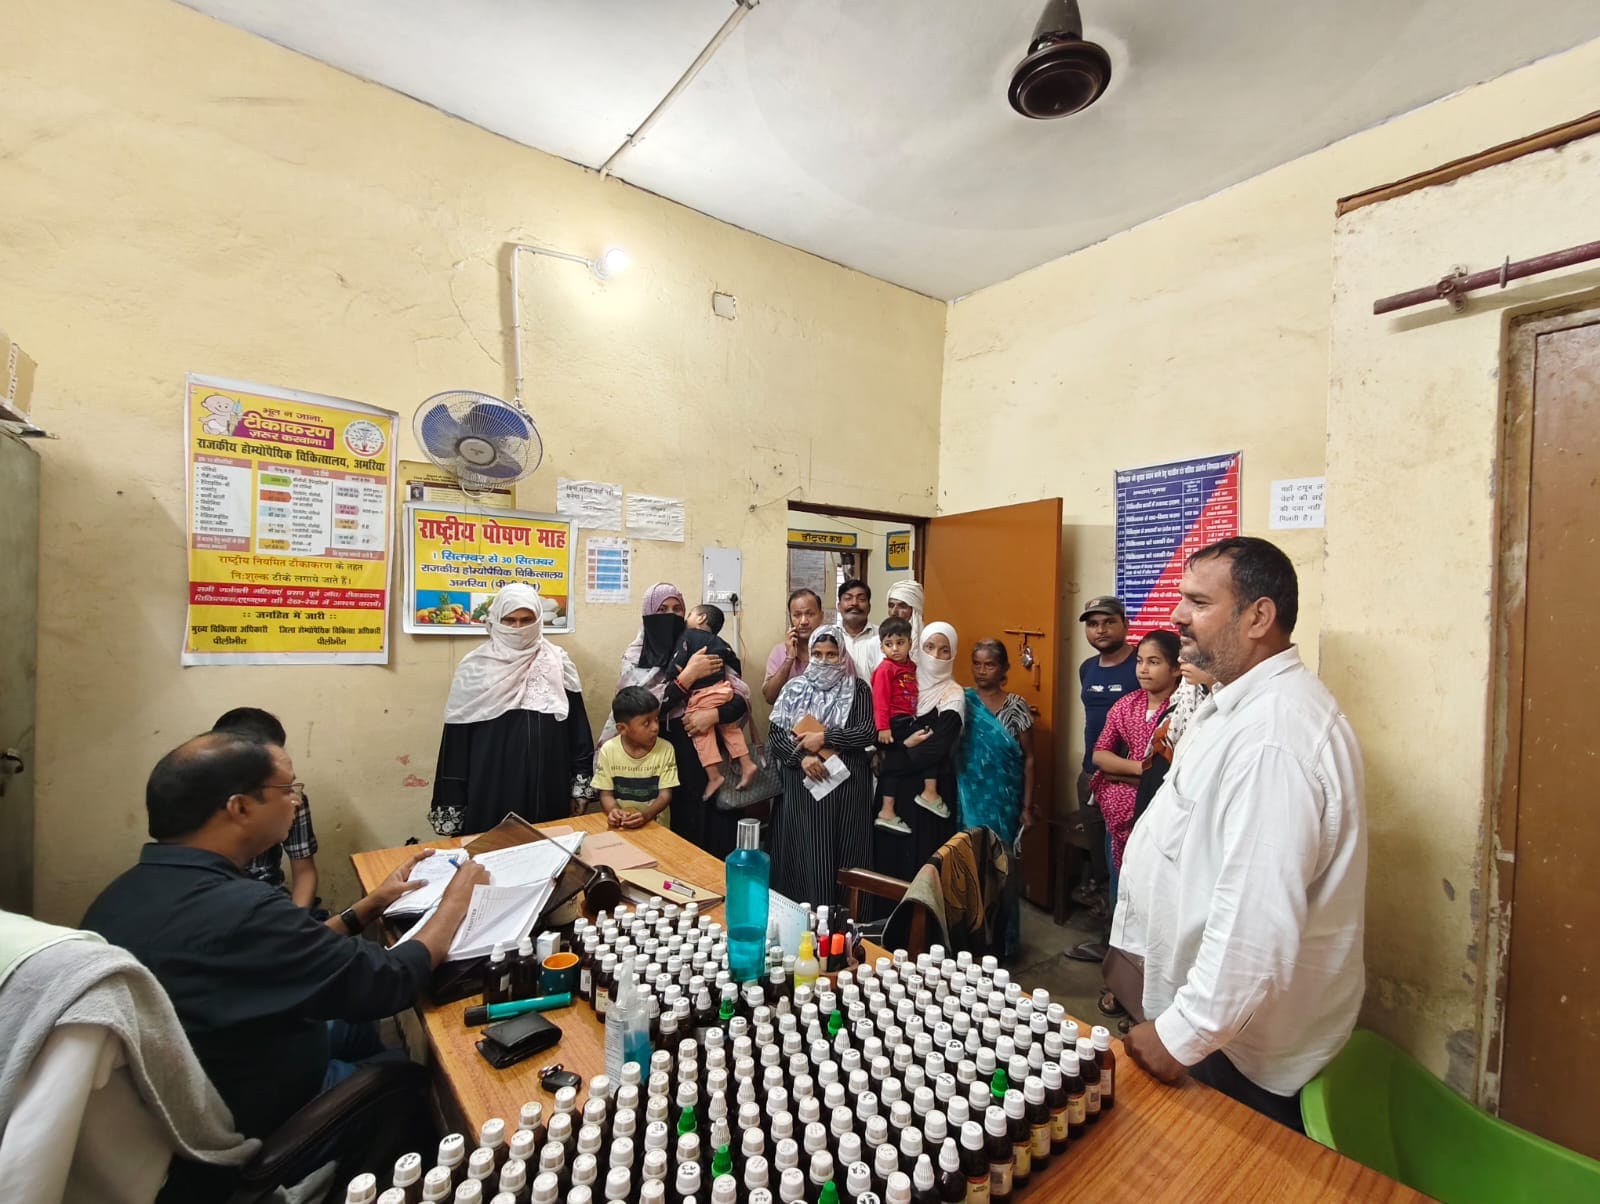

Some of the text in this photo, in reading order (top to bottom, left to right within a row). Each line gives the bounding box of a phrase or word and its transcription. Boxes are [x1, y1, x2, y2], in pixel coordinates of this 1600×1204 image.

[263, 408, 280, 417] भूल
[243, 412, 332, 439] टीकाकरण
[197, 438, 386, 472] राजकीय होम्योपैथिक चिकित्सालय, अमरिया
[418, 516, 566, 548] राष्ट्रीय पोषण माह
[889, 541, 906, 554] डॉट्स
[218, 555, 363, 572] राष्ट्रीय नियमित टीकाकरण के तहत
[442, 550, 484, 562] सितम्बर
[488, 554, 498, 563] से
[502, 556, 512, 564] 30
[516, 554, 554, 566] सितम्बर
[272, 572, 291, 582] टीके
[322, 575, 338, 584] जाते
[421, 564, 563, 579] राजकीय होम्योपैथिक चिकित्सालय
[449, 578, 487, 588] अमरिया
[256, 610, 289, 619] जनहित
[293, 610, 302, 620] में
[305, 611, 325, 620] जारी
[213, 636, 247, 645] पीलीभीत
[317, 636, 346, 645] पीलीभीत
